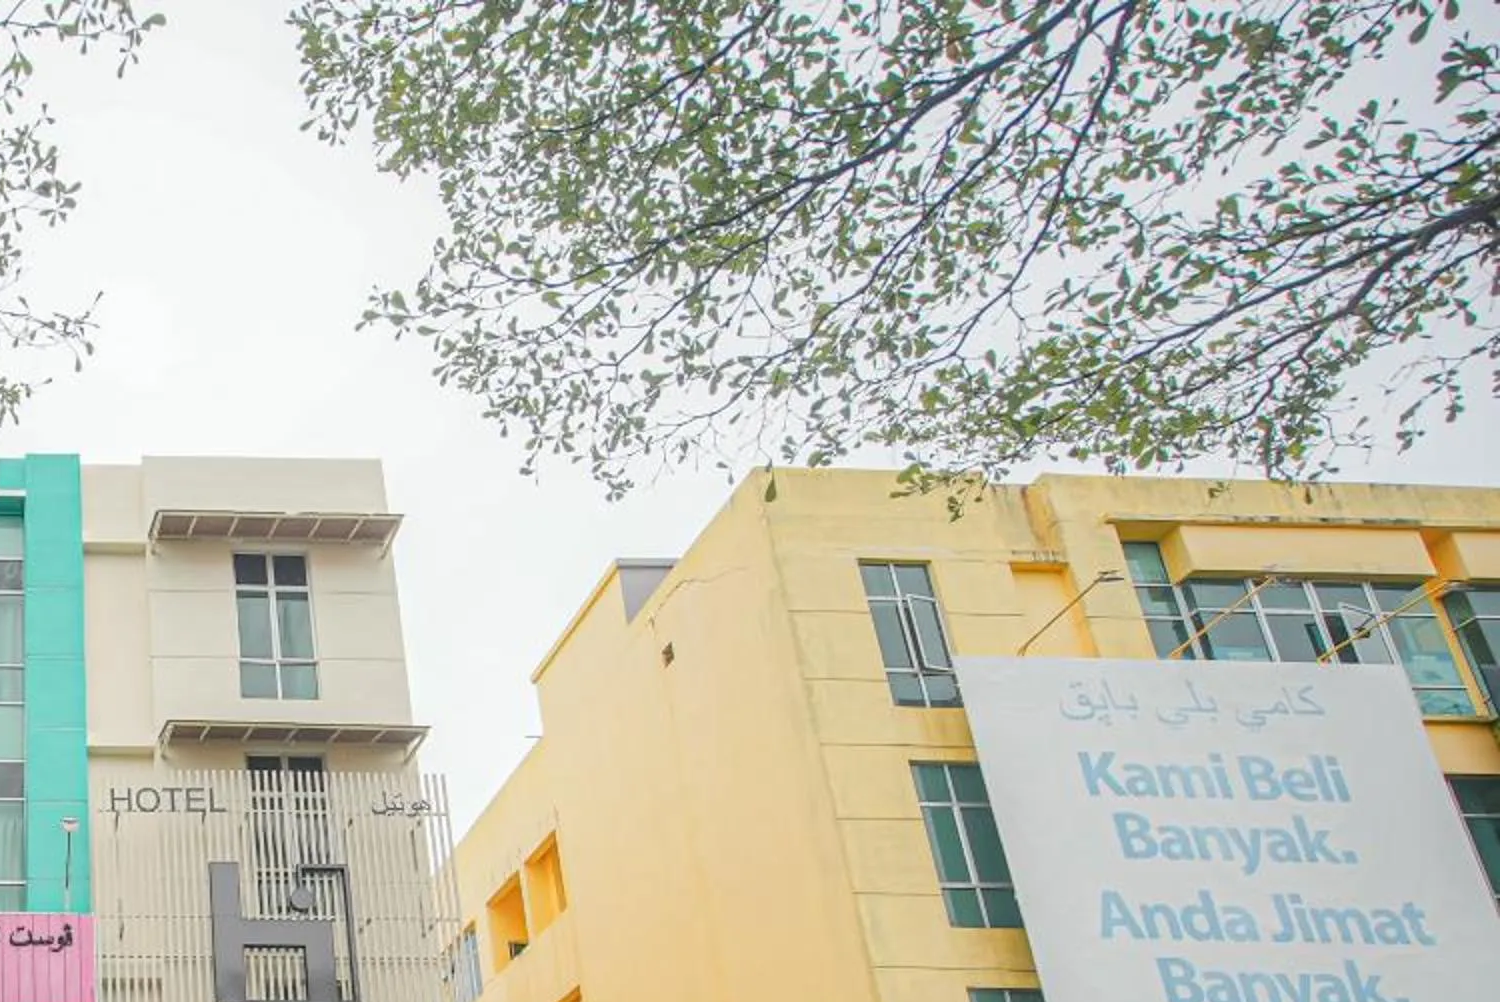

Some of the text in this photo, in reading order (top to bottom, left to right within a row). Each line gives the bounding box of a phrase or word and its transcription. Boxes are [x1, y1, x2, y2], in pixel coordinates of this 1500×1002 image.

[109, 787, 227, 813] HOTEL
[1077, 751, 1352, 802] Kami Beli
[1112, 811, 1359, 876] Banyak.
[1101, 889, 1438, 947] Anda Jimat
